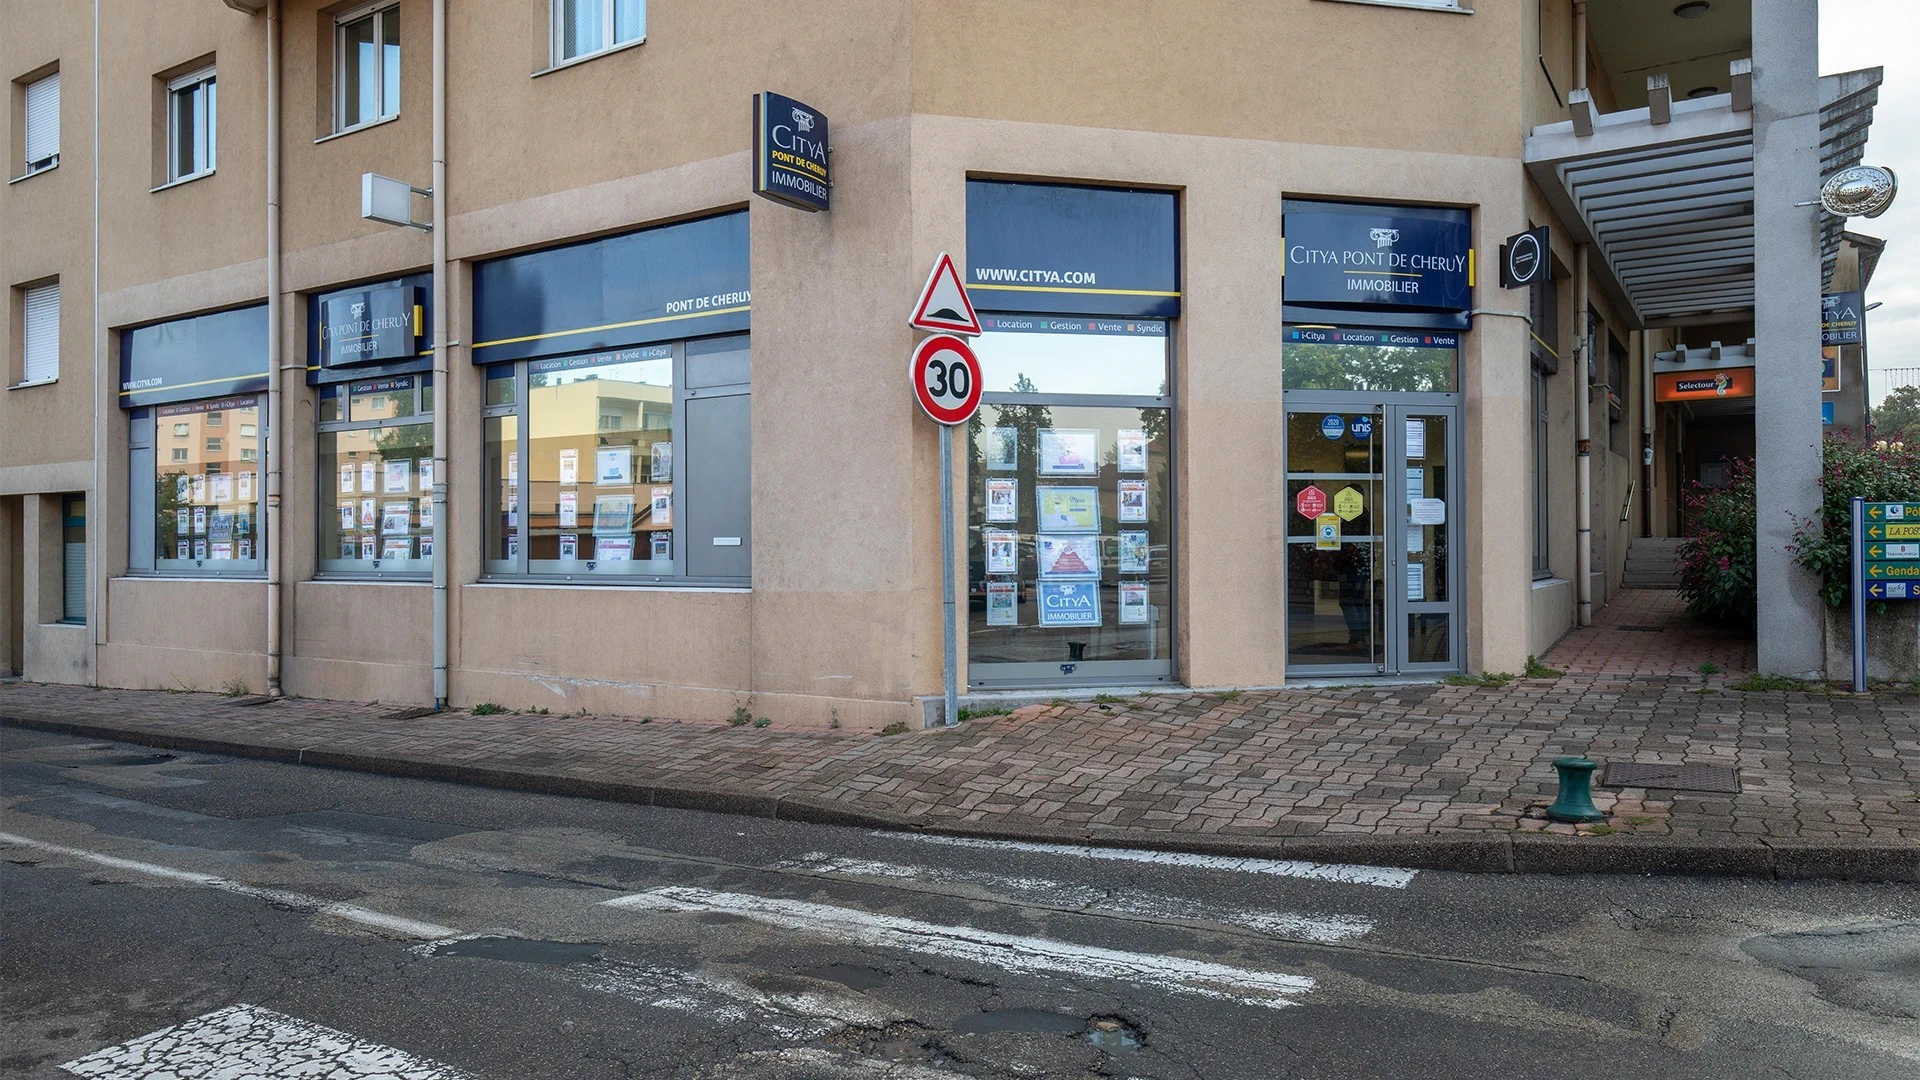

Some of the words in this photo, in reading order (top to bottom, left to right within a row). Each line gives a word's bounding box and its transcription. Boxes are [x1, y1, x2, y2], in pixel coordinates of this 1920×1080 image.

[771, 124, 827, 165] CITYA
[772, 150, 795, 164] PONT
[795, 157, 806, 167] DE
[806, 161, 827, 177] CHERUY
[772, 170, 828, 201] IMMOBILIER
[1290, 245, 1338, 264] CITYA
[1343, 250, 1385, 267] PONT
[1389, 252, 1407, 268] DE
[1410, 253, 1466, 273] CHERUY
[975, 267, 1096, 285] WWW.CITYA.COM
[1347, 278, 1419, 294] IMMOBILIER
[666, 299, 694, 314] PONT
[695, 296, 710, 309] DE
[1821, 306, 1857, 320] TYA
[339, 321, 358, 335] PONT
[359, 320, 370, 332] DE
[371, 311, 411, 331] CHERUY
[997, 319, 1033, 329] Location
[1050, 321, 1082, 331] Gestion
[1098, 322, 1122, 332] Vente
[1136, 323, 1163, 334] Syndic
[1831, 320, 1857, 328] CHERUY
[1301, 331, 1326, 341] i-Citya
[1342, 332, 1375, 342] Location
[1390, 334, 1419, 344] Gestion
[1433, 335, 1455, 345] Vente
[1821, 330, 1858, 340] OBILIER
[340, 340, 378, 355] IMMOBILIER
[540, 361, 562, 370] Location
[568, 358, 589, 367] Gestion
[596, 355, 613, 363] Vente
[622, 351, 640, 362] Syndic
[648, 348, 667, 358] i-Citya
[357, 383, 372, 392] Gestion
[377, 382, 389, 390] Vente
[395, 379, 409, 389] Syndic
[928, 359, 970, 399] 30
[1678, 382, 1714, 390] Selectour
[1889, 527, 1901, 536] LA
[1902, 526, 1920, 536] POS
[1886, 565, 1920, 576] Genda
[1046, 594, 1092, 608] CITYA
[1047, 611, 1093, 621] IMMOBILIER
